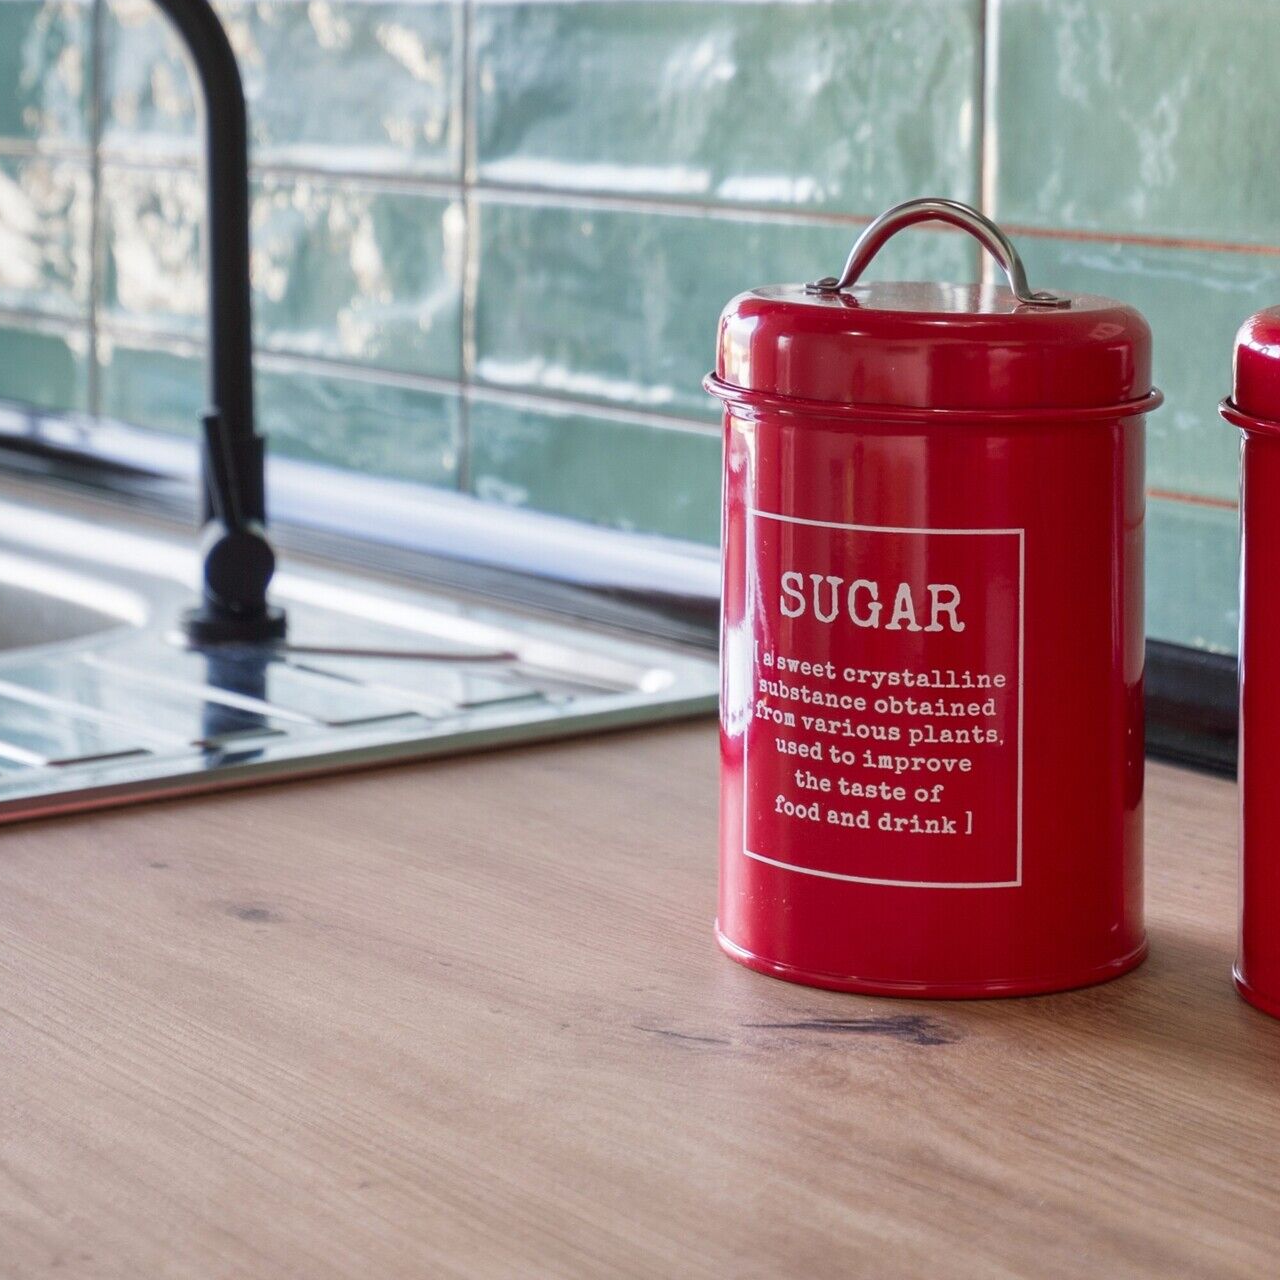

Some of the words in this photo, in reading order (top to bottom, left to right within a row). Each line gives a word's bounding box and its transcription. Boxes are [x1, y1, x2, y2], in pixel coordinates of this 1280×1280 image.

[780, 571, 965, 632] SUGAR
[777, 657, 836, 679] sweet
[844, 668, 1006, 689] crystalline
[758, 677, 866, 712] substance
[874, 697, 996, 716] obtained
[755, 700, 795, 727] from
[801, 716, 900, 740] various
[909, 725, 1003, 746] plants,
[775, 738, 822, 760] used
[829, 747, 855, 765] to
[863, 750, 971, 774] improve
[795, 770, 831, 792] the
[838, 777, 905, 800] taste
[915, 785, 944, 802] of
[775, 795, 820, 821] food
[827, 810, 870, 828] and
[878, 814, 956, 833] drink
